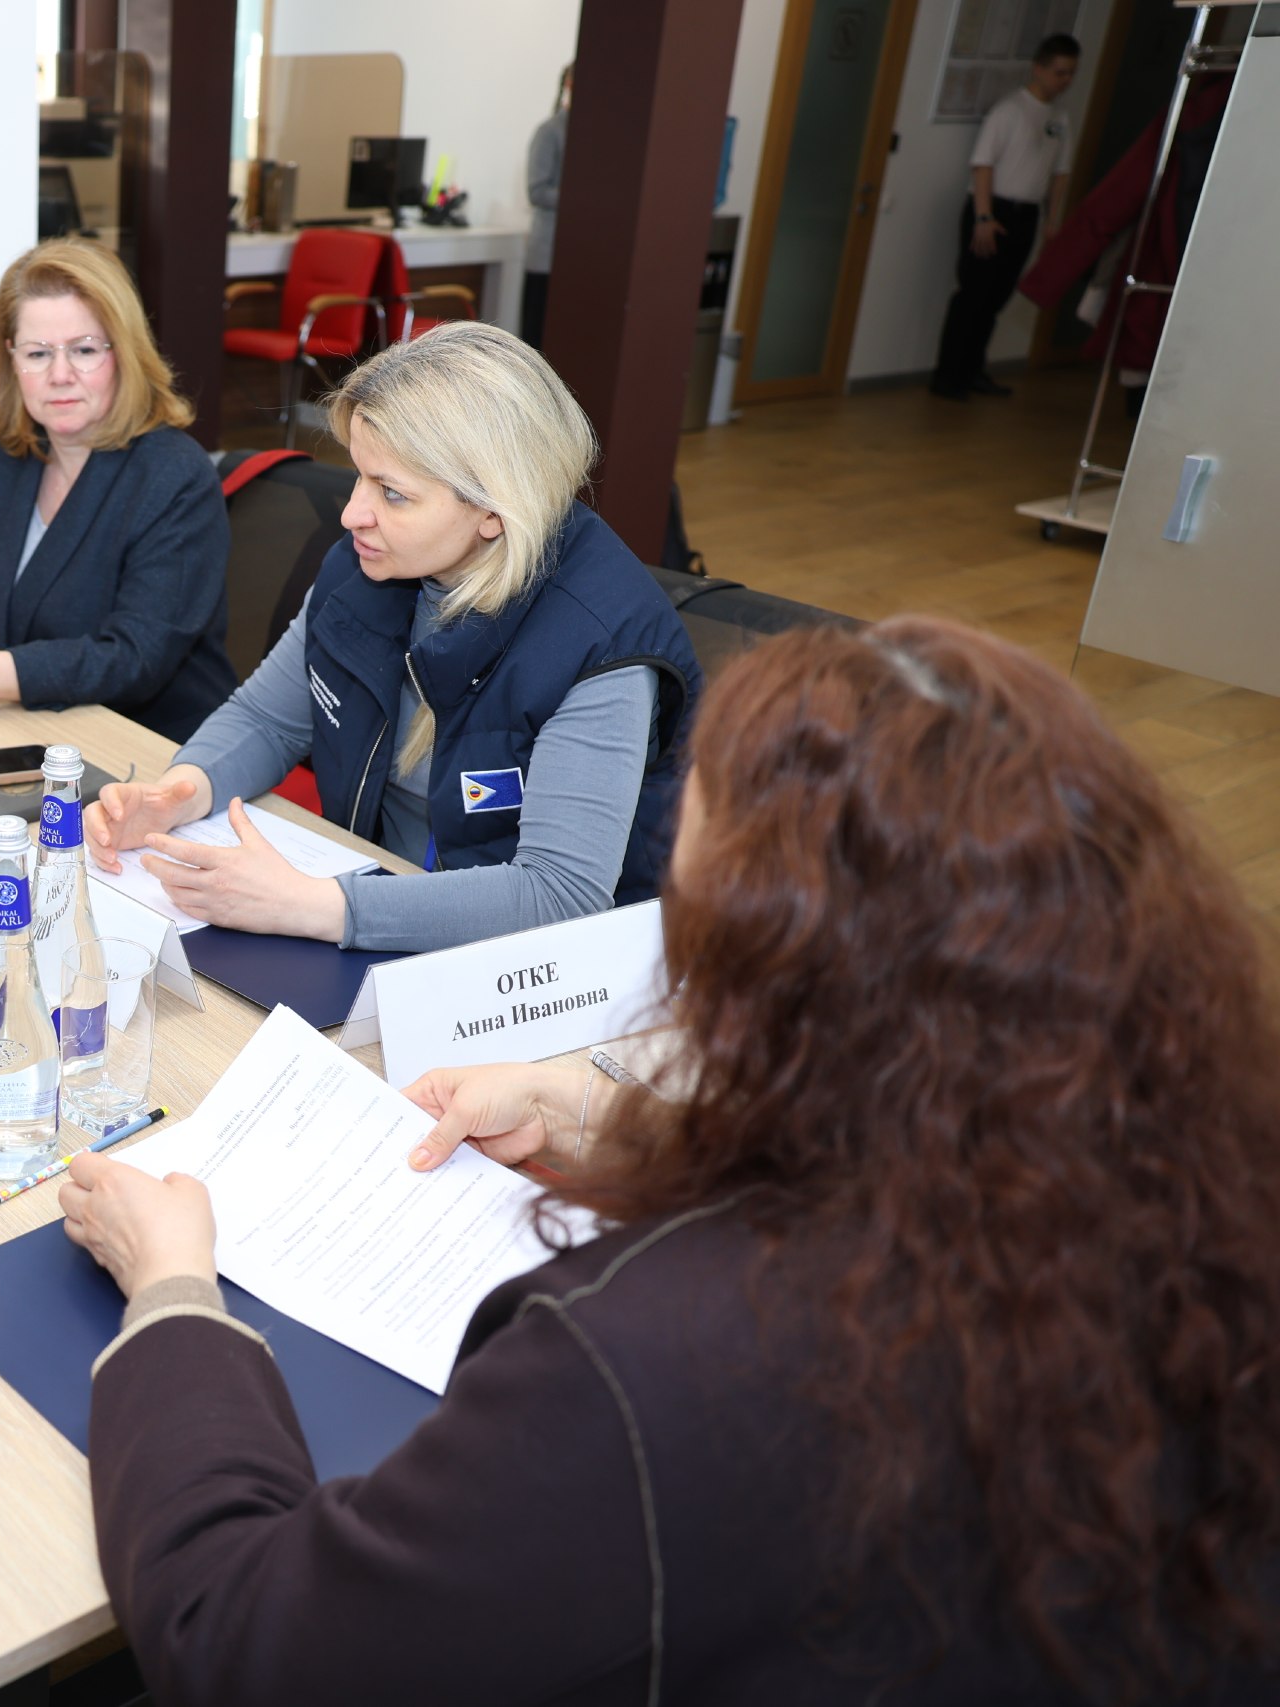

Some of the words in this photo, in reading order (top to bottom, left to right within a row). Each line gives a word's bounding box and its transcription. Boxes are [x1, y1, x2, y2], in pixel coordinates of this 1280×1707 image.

[497, 961, 559, 995] ОТКЕ
[452, 1013, 506, 1042] Анна
[511, 987, 609, 1025] Ивановна
